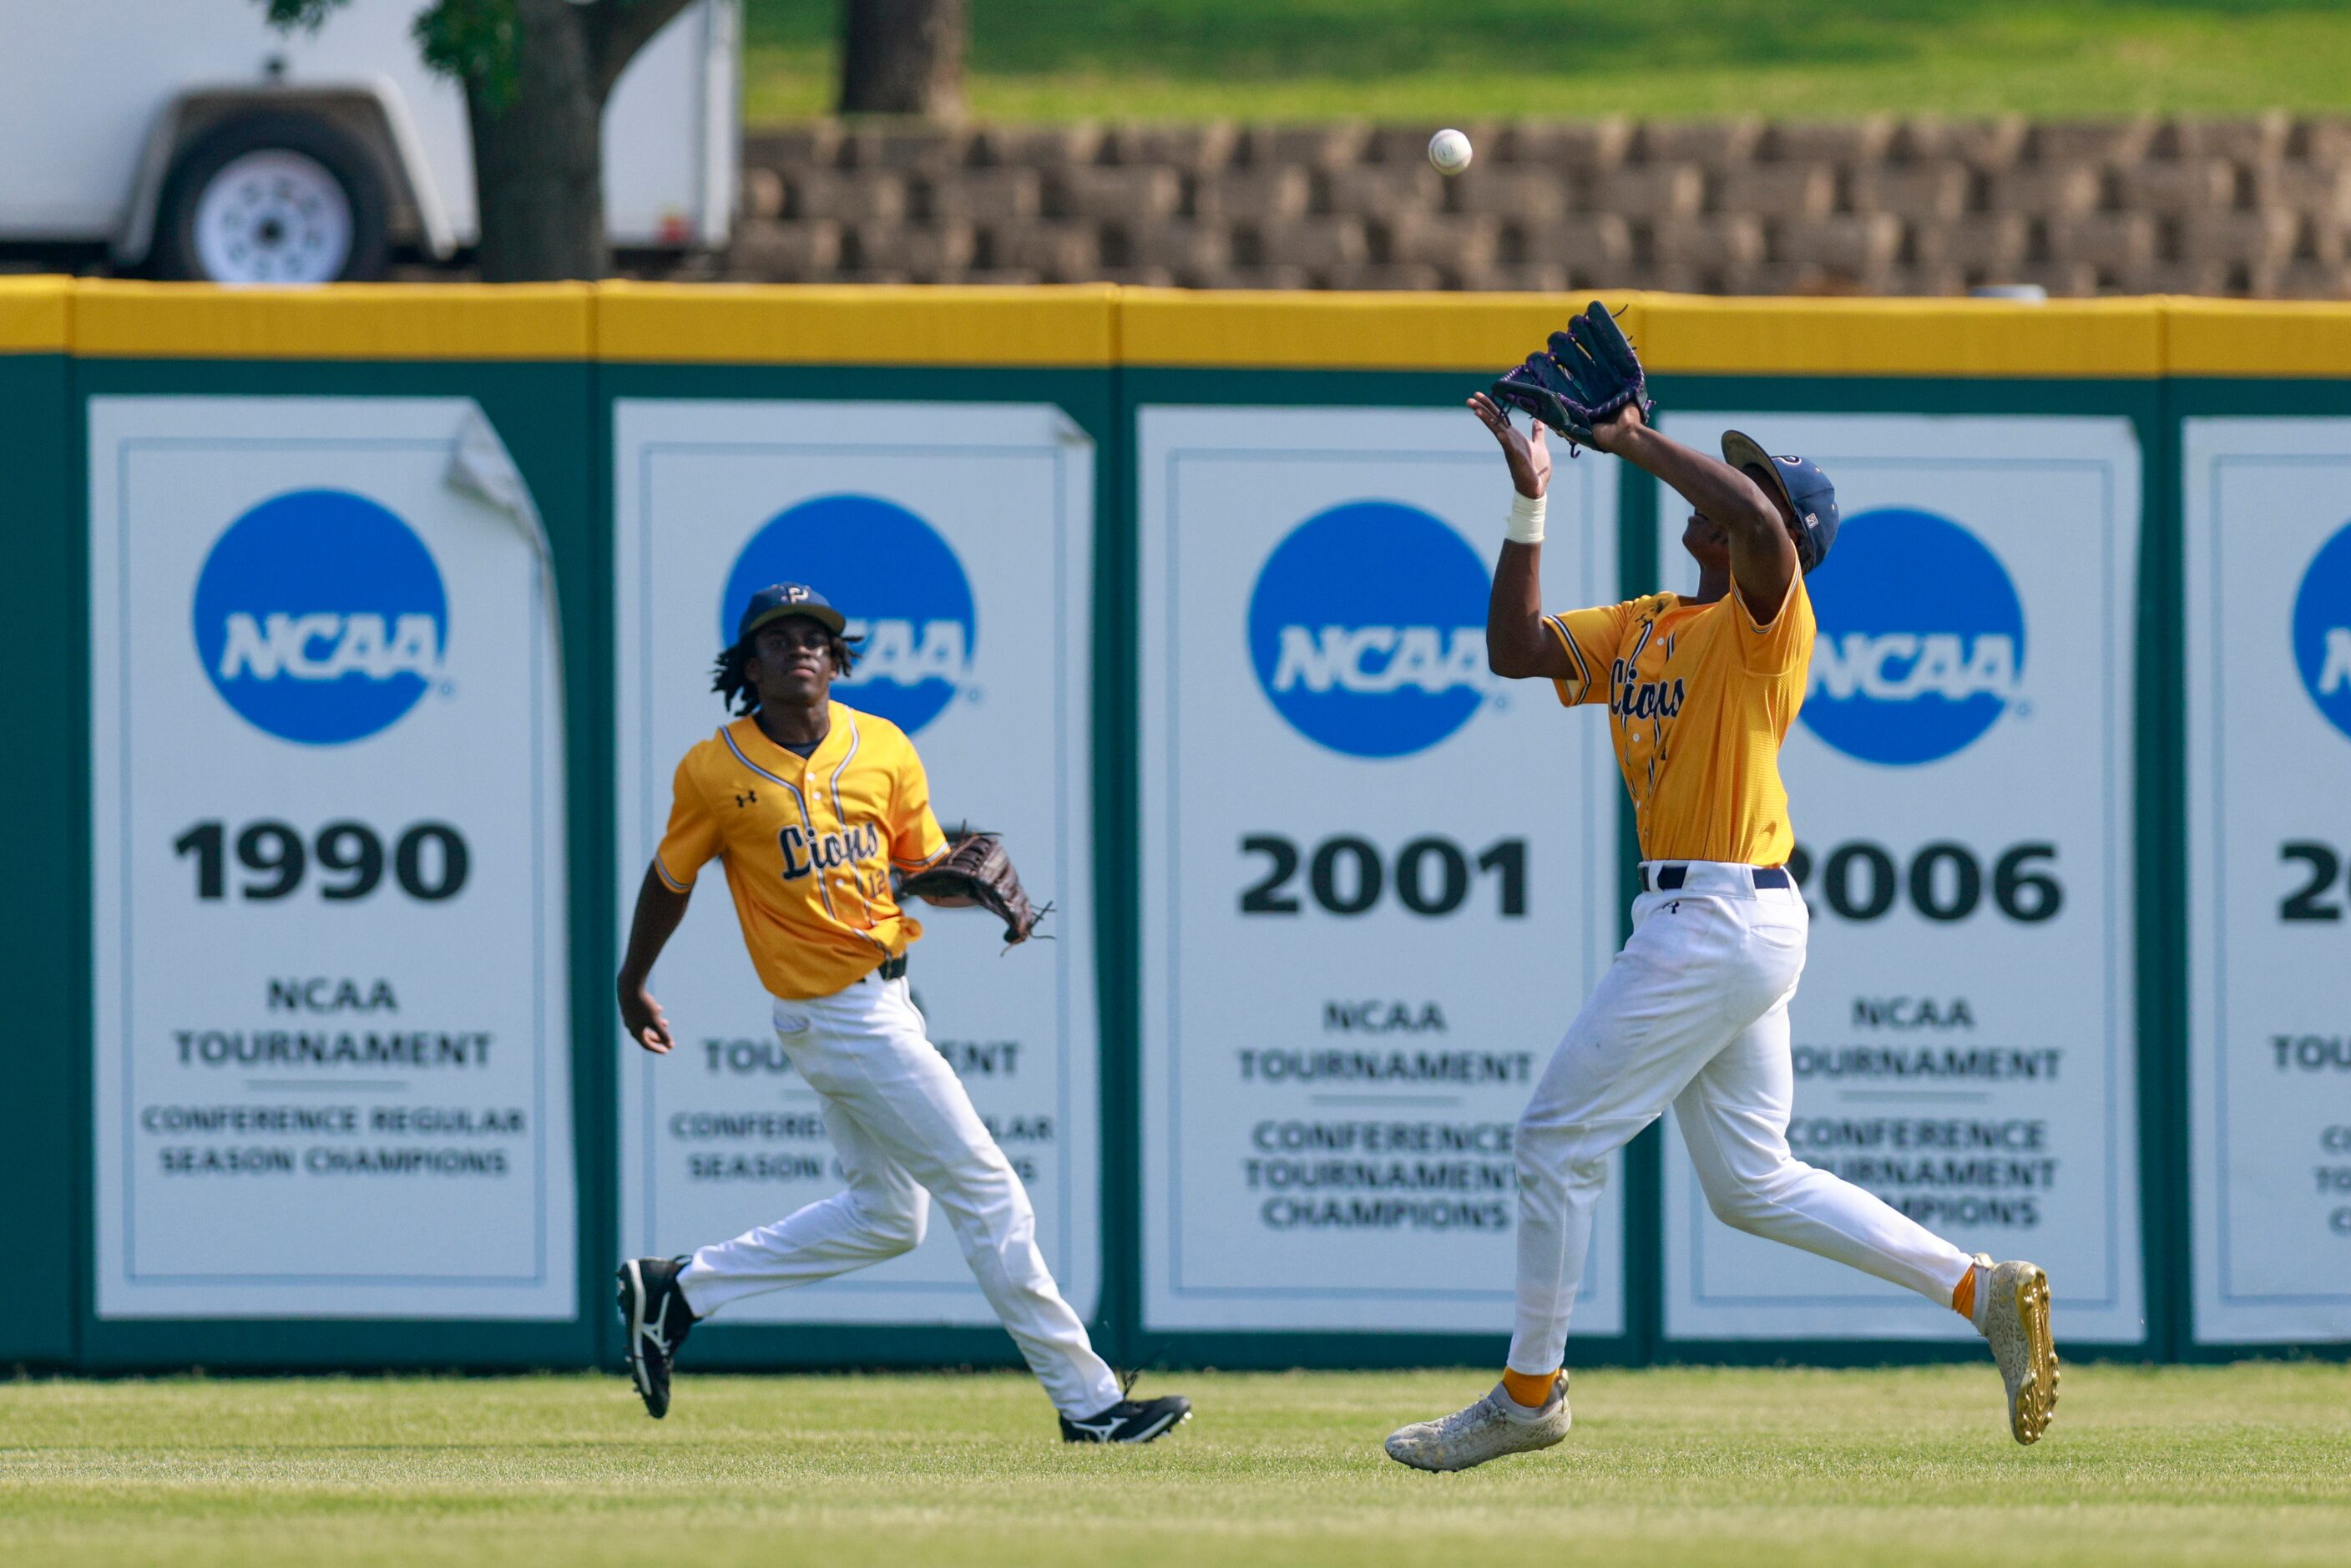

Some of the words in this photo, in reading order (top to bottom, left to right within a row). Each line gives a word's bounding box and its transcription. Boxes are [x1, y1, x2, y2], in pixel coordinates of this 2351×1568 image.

[219, 613, 442, 681] NCAA
[827, 618, 970, 686] AA
[1272, 627, 1494, 693] NCAA
[1805, 633, 2024, 701] NCAA
[172, 818, 472, 904] 1990
[778, 822, 877, 880] Lions
[868, 868, 885, 898] 12
[1237, 833, 1529, 919] 2001
[266, 978, 399, 1014] NCAA
[1323, 1000, 1447, 1034] NCAA
[1852, 997, 1975, 1030] NCAA
[174, 1030, 492, 1067] TOURNAMENT
[1792, 1046, 2060, 1080] OURNAMENT
[1239, 1050, 1531, 1085] TOURNAMENT
[141, 1106, 357, 1135] CONFERENCE
[369, 1106, 527, 1136] REGULAR
[1252, 1121, 1514, 1154] CONFERENCE
[1787, 1119, 2045, 1151] CONFERENCE
[159, 1147, 295, 1176] SEASON
[304, 1147, 509, 1177] CHAMPIONS
[687, 1153, 825, 1182] SEASON
[1261, 1198, 1510, 1232] CHAMPIONS
